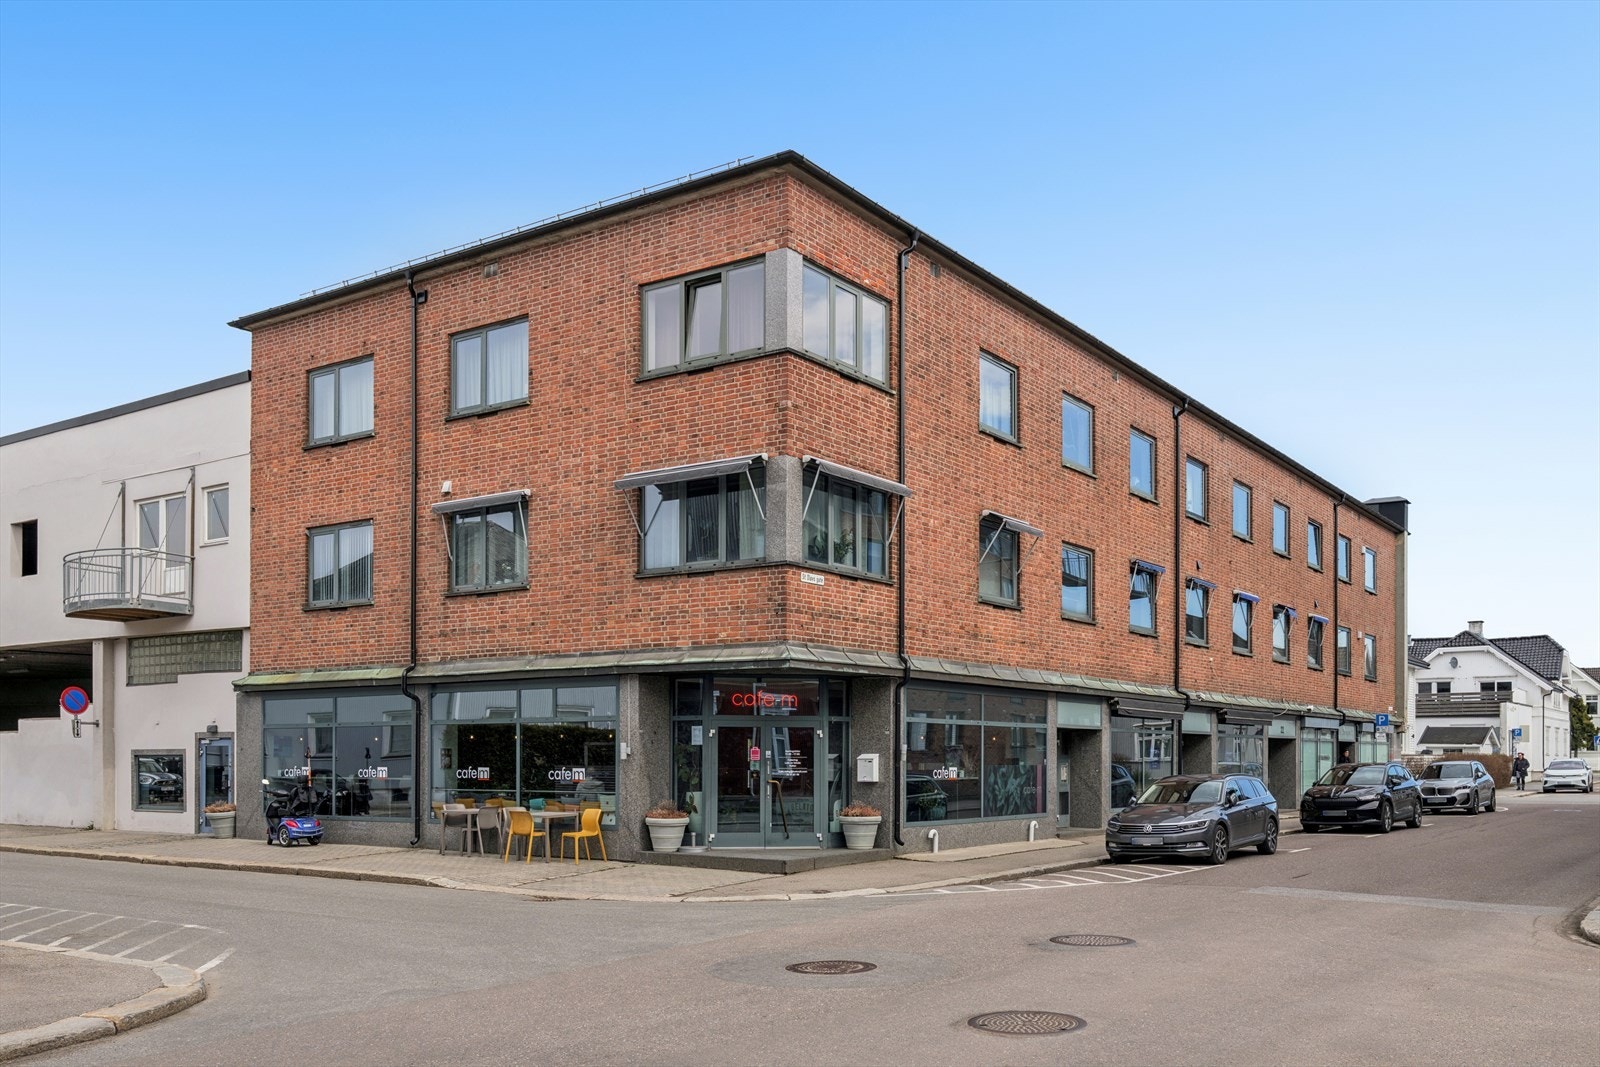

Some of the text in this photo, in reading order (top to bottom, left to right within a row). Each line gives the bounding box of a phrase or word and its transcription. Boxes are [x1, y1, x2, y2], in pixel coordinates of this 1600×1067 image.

[732, 690, 798, 707] cafe m
[1378, 715, 1385, 725] P
[358, 766, 377, 778] cafe
[456, 766, 477, 779] cafe
[548, 767, 571, 780] cafe
